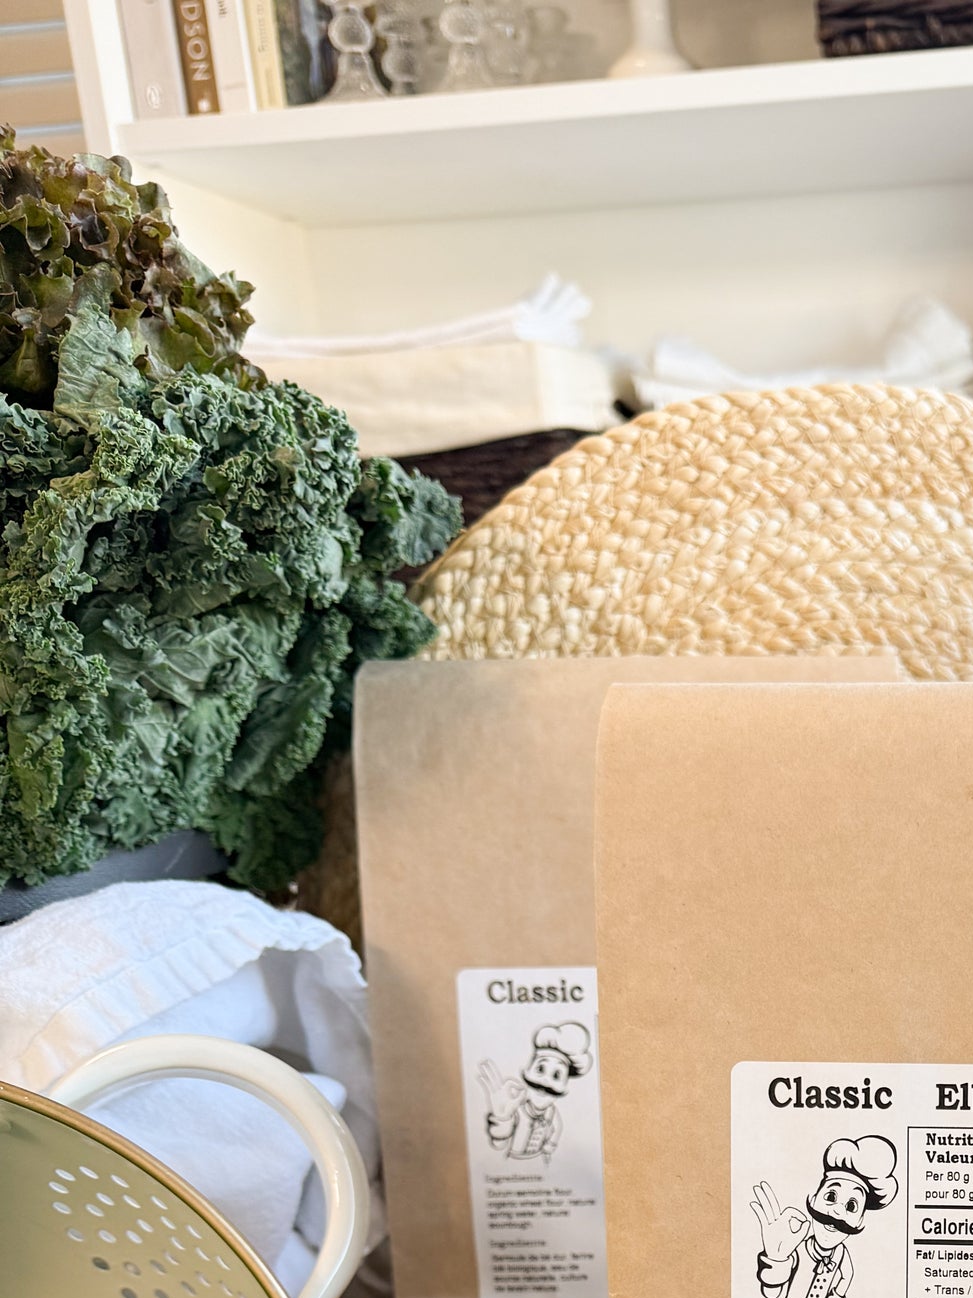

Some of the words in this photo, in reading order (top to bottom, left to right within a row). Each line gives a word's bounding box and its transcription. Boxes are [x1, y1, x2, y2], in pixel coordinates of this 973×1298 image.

[487, 979, 583, 1004] Classic
[768, 1076, 892, 1109] Classic
[926, 1171, 944, 1181] Per
[947, 1171, 960, 1181] 80
[963, 1174, 969, 1184] g
[925, 1191, 949, 1201] pour
[952, 1189, 965, 1199] 80
[934, 1285, 964, 1295] Trans
